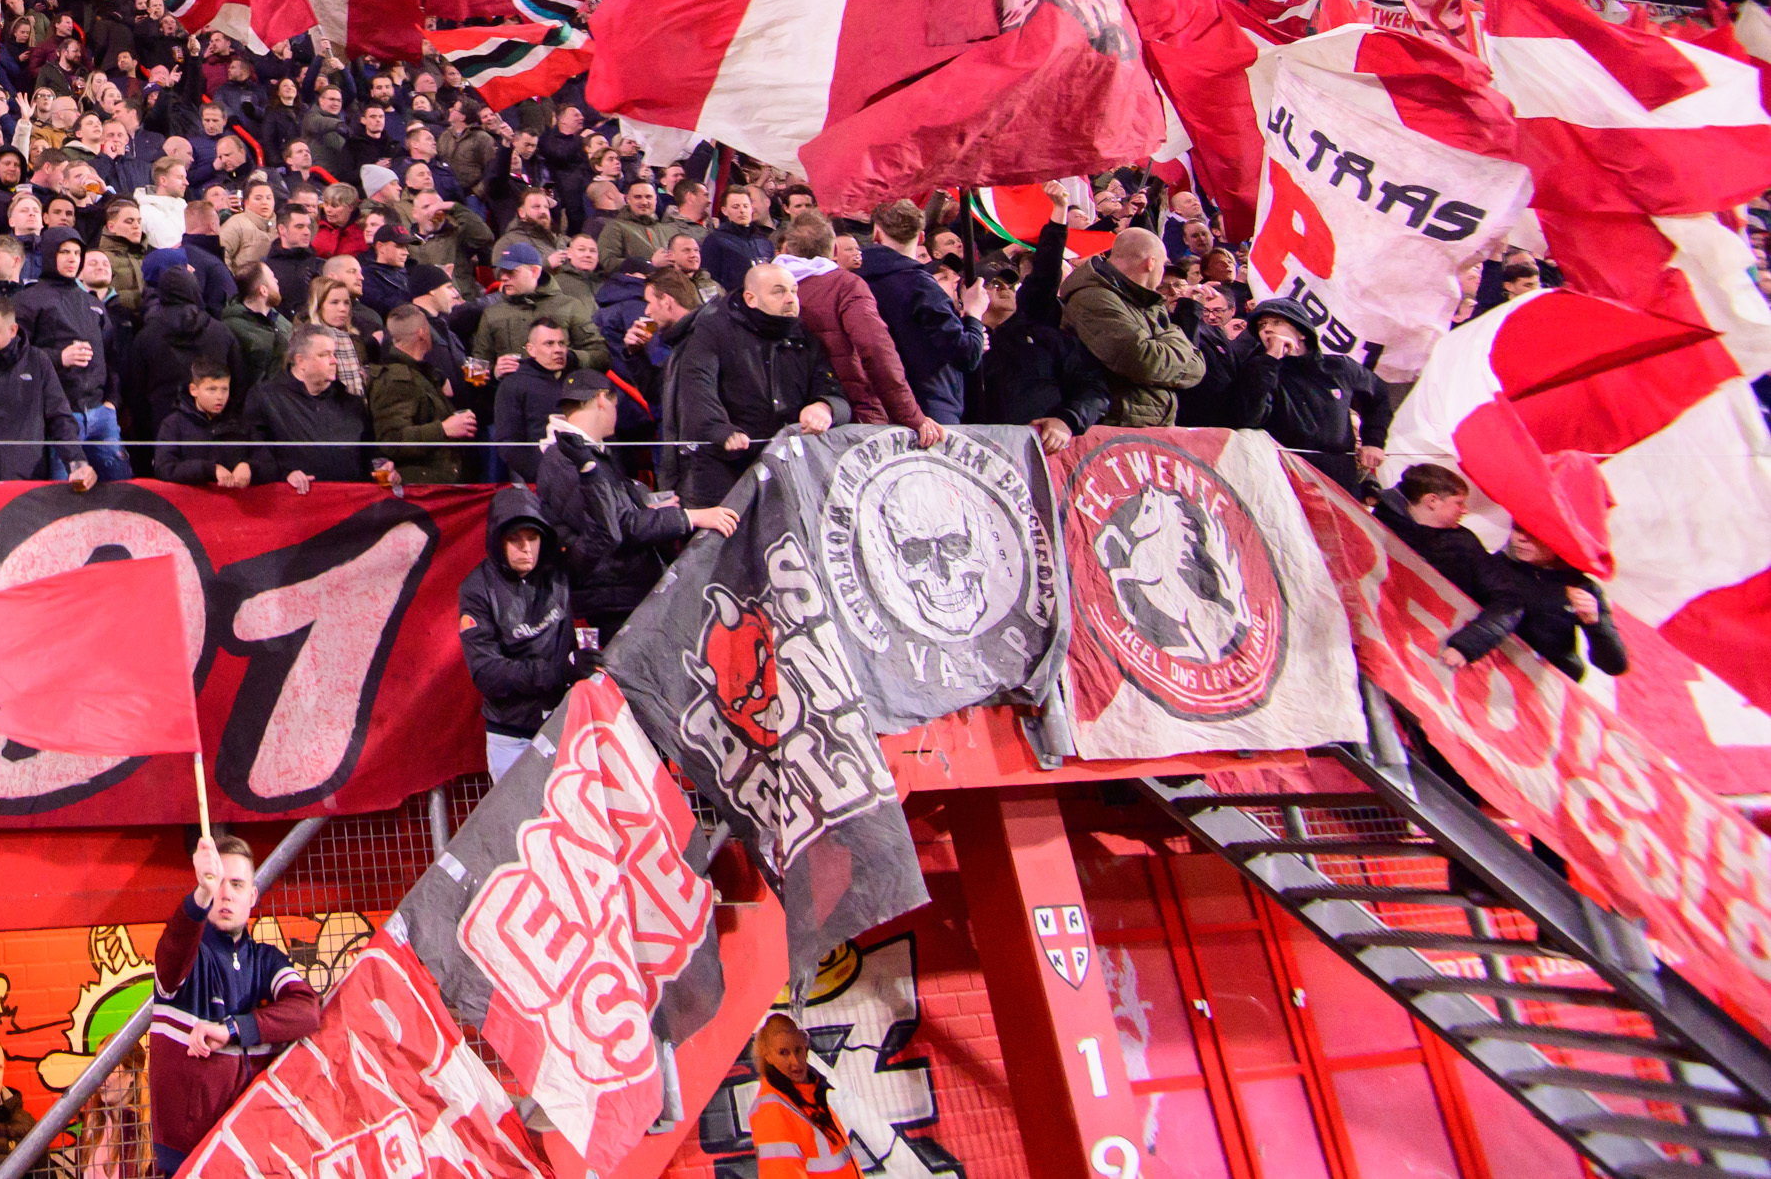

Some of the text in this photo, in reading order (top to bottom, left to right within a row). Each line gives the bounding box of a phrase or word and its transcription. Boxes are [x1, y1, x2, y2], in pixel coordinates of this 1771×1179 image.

[1267, 106, 1487, 242] ULTRAS
[944, 433, 993, 475] VAN
[1075, 450, 1229, 525] FC TWENTE
[1170, 661, 1199, 689] ONS
